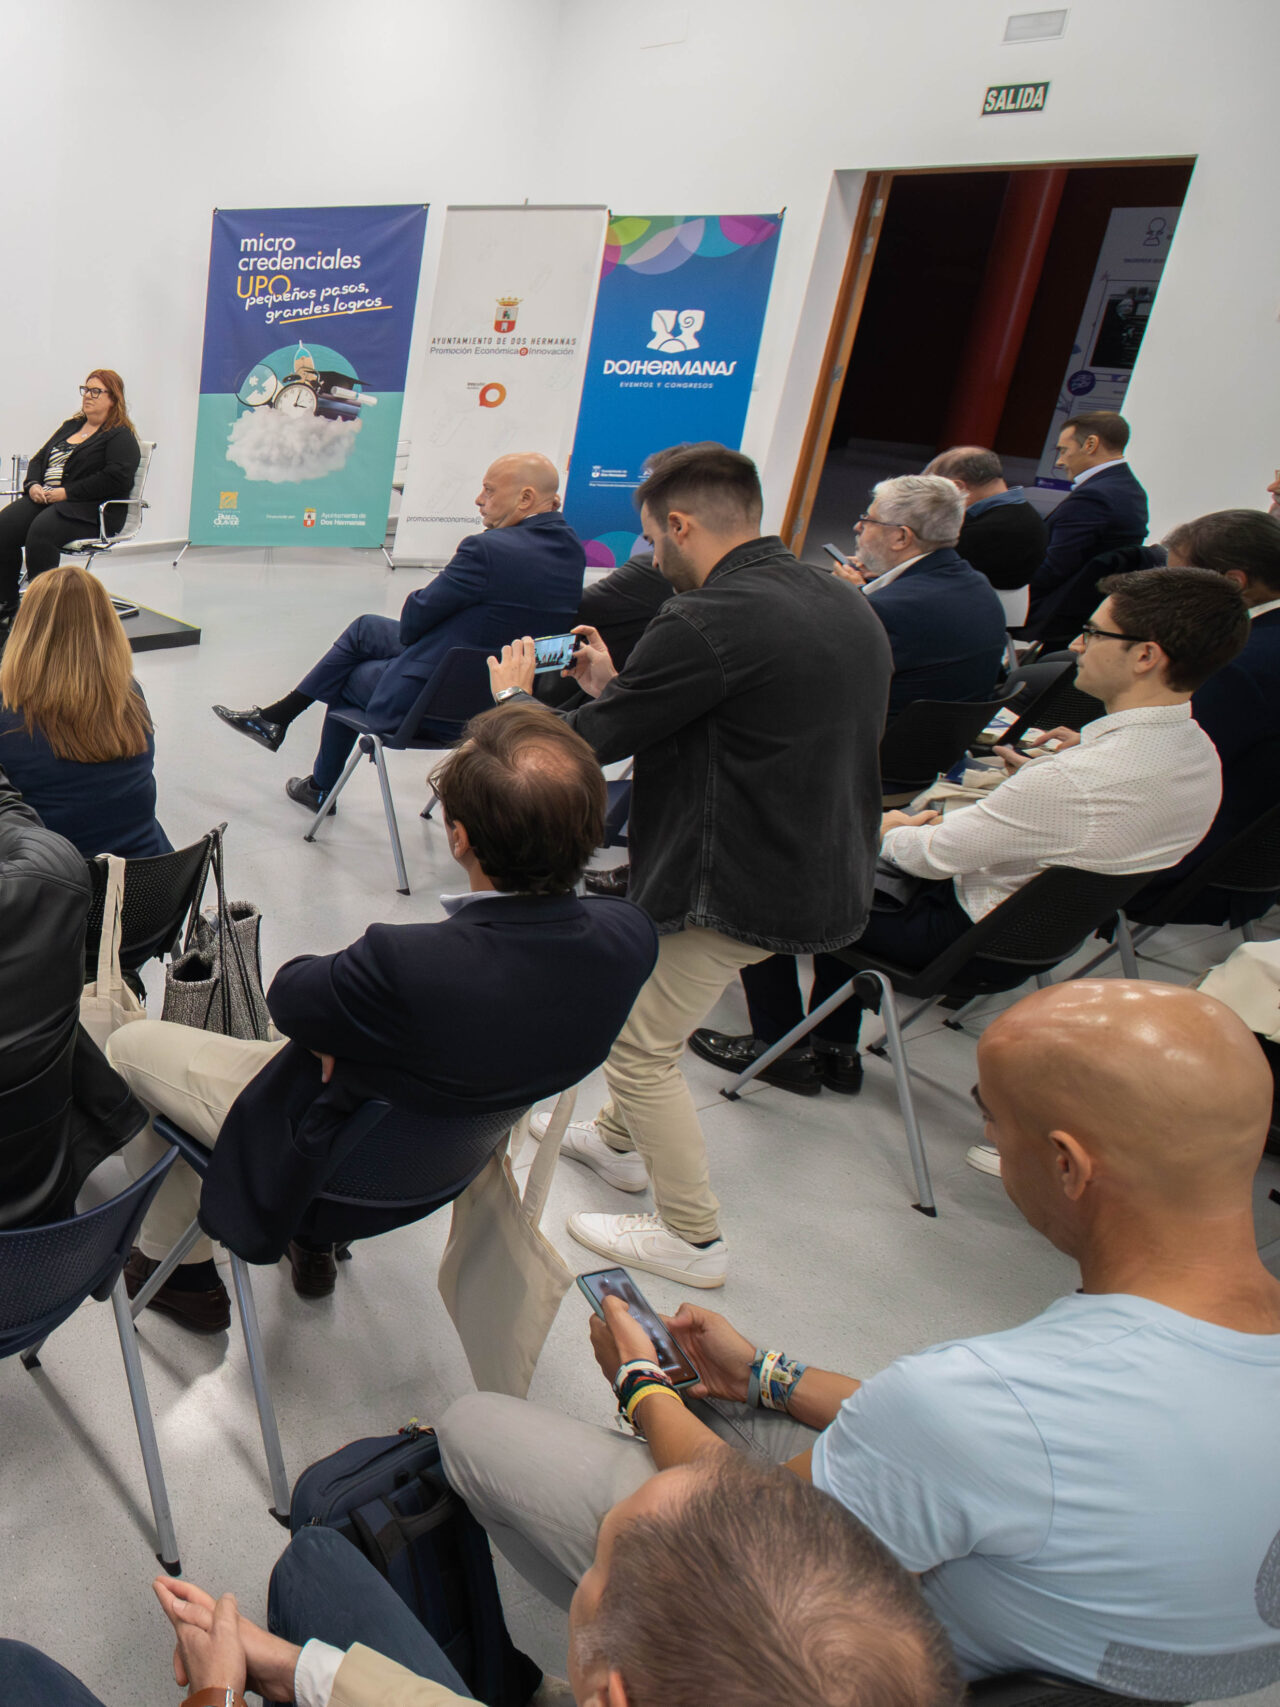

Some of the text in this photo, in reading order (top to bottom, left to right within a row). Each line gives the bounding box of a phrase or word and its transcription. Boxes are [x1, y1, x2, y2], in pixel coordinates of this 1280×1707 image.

[984, 85, 1044, 112] SALIDA
[240, 233, 296, 252] micro
[238, 248, 361, 271] credenciales
[237, 275, 291, 298] UPO
[245, 283, 369, 310] pequeños pasos,
[265, 297, 382, 324] grandes logros
[430, 346, 472, 355] Promoción
[474, 346, 518, 355] Económica
[529, 347, 574, 355] Innovación
[432, 337, 492, 345] AYUNTAMIENTO
